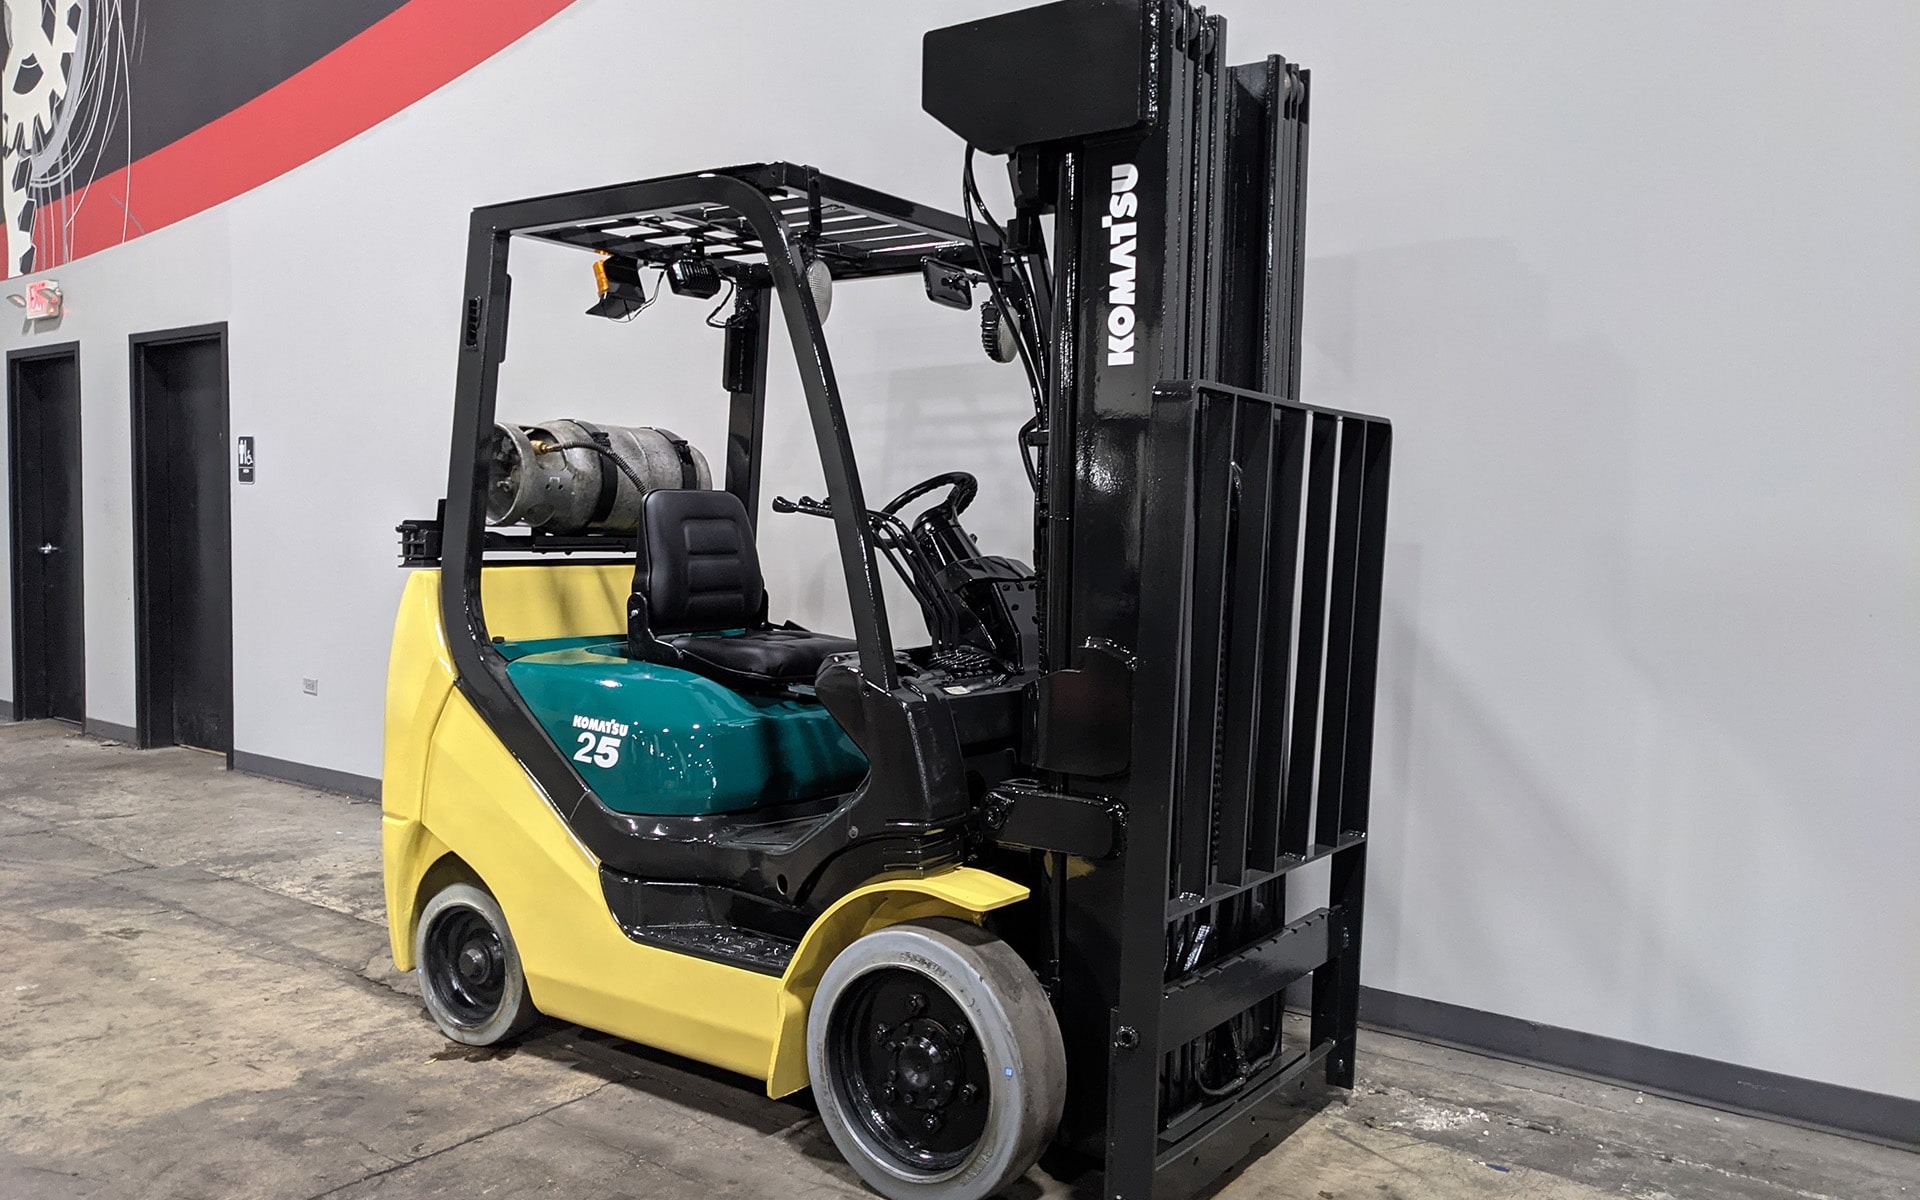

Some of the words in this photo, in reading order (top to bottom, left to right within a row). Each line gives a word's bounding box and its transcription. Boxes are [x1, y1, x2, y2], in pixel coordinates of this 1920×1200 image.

[1102, 163, 1139, 366] KOMATSU
[572, 714, 629, 737] KOMATSU
[573, 731, 621, 768] 25
